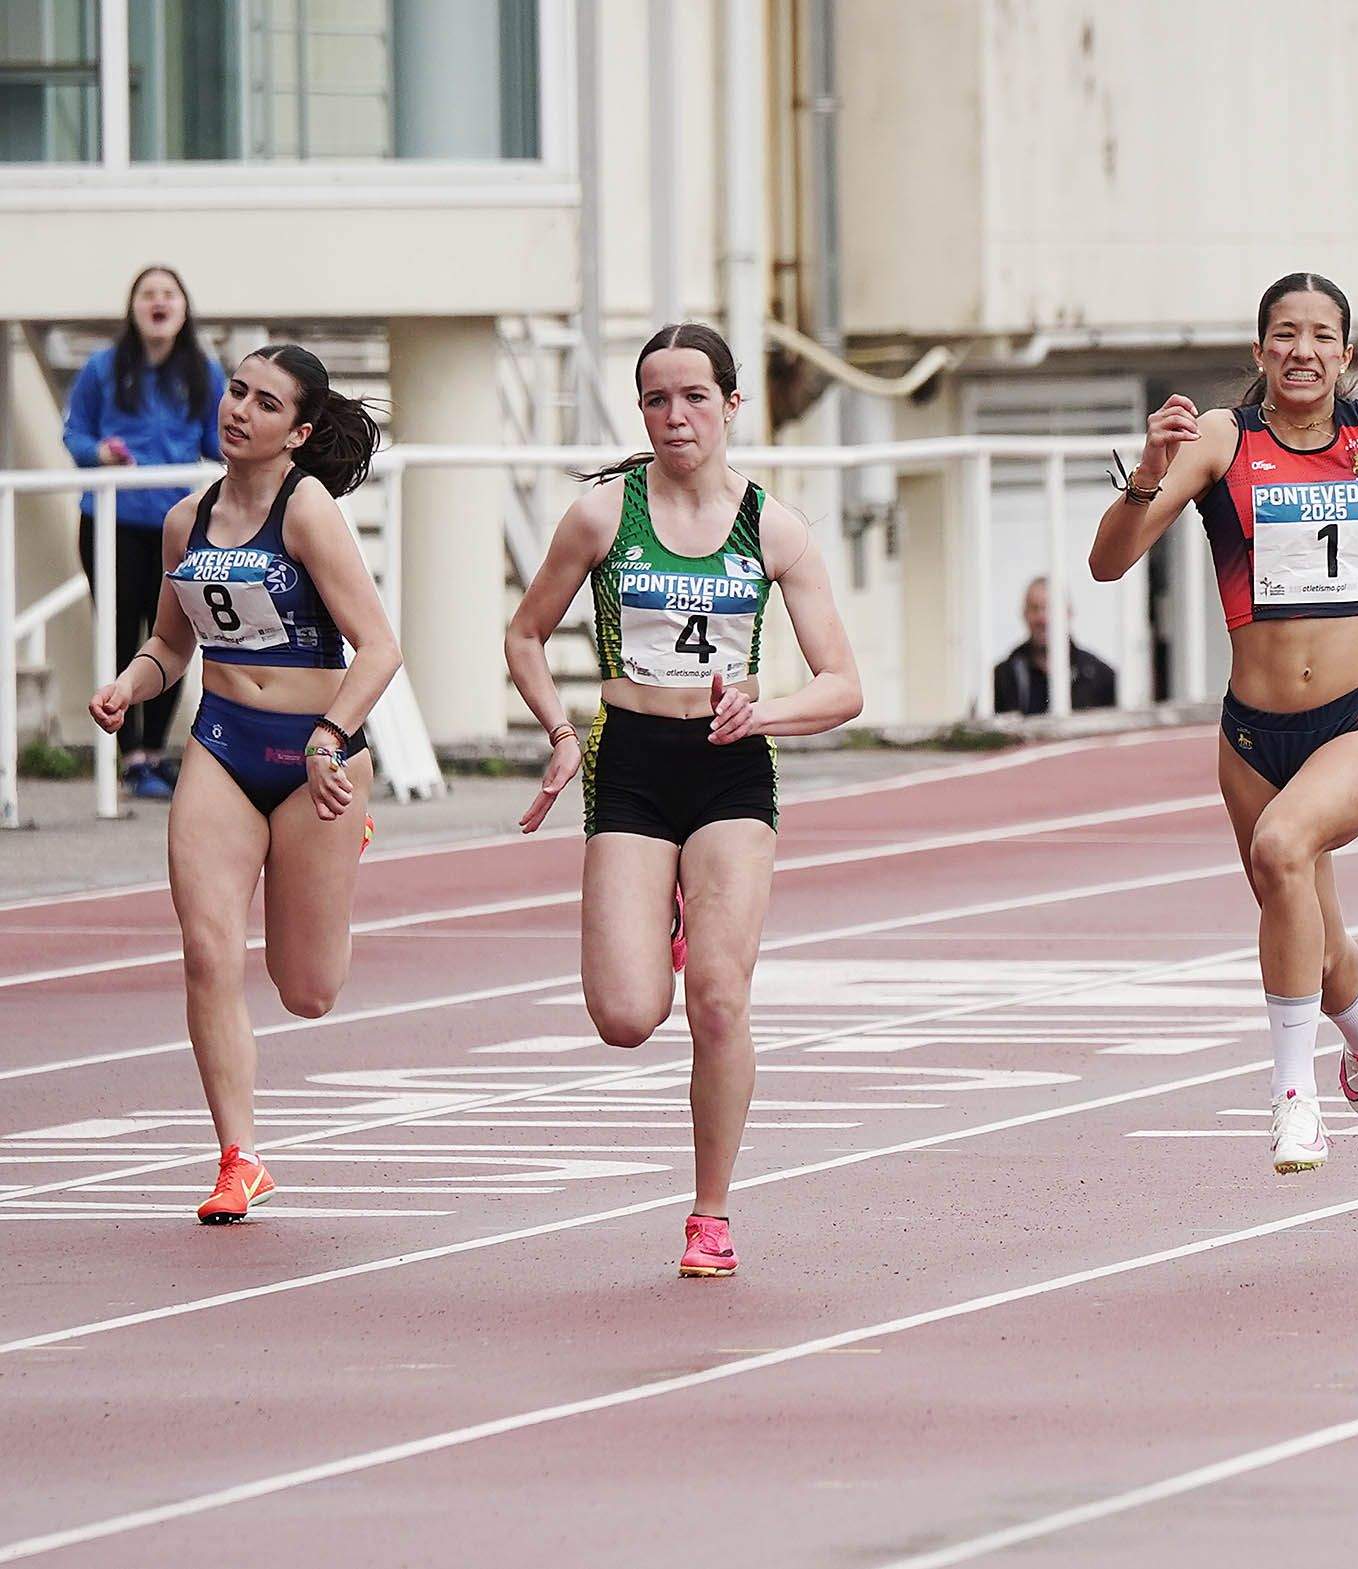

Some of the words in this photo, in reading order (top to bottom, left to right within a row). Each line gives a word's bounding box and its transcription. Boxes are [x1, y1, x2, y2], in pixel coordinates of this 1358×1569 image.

[1301, 503, 1348, 521] 2025
[1317, 523, 1339, 578] 1
[193, 566, 230, 581] 2025
[611, 562, 652, 571] VIATOR
[623, 574, 758, 599] PONTEVEDRA
[203, 584, 242, 631] 8
[665, 593, 713, 612] 2025
[675, 614, 717, 664] 4
